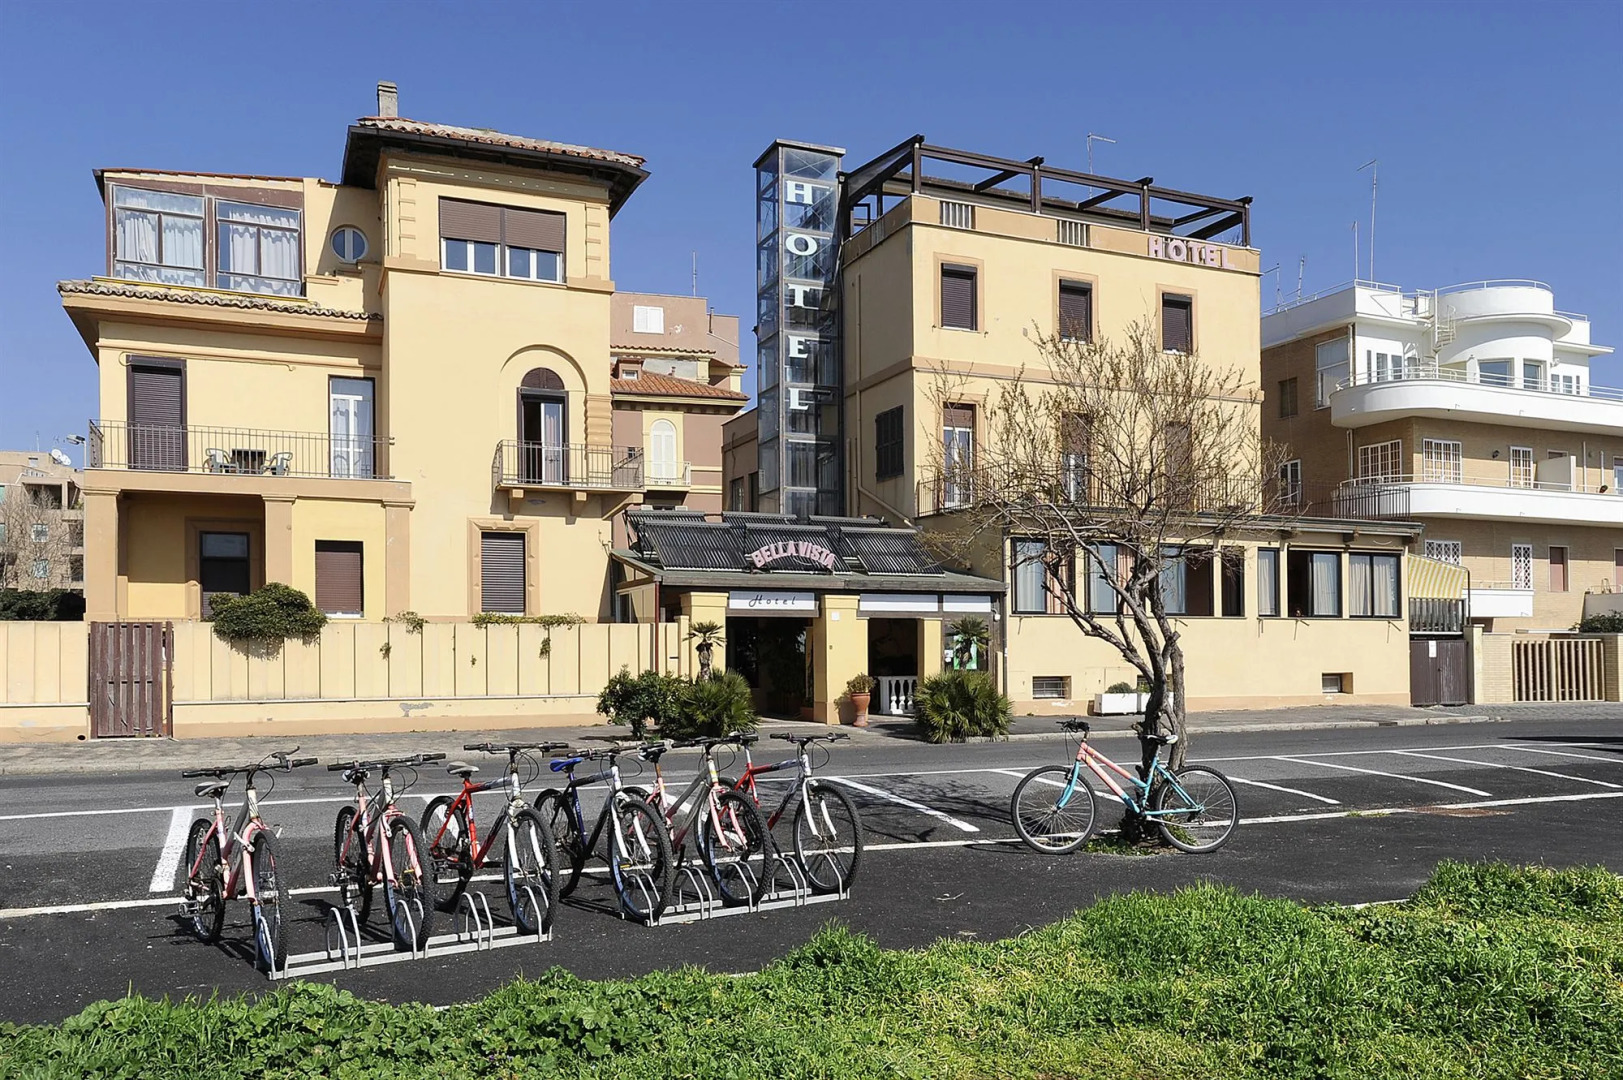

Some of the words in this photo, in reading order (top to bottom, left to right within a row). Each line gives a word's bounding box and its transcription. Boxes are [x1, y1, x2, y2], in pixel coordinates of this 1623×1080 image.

[1148, 236, 1235, 269] HOTEL
[785, 180, 818, 411] HOTEL
[748, 595, 796, 607] Hotel
